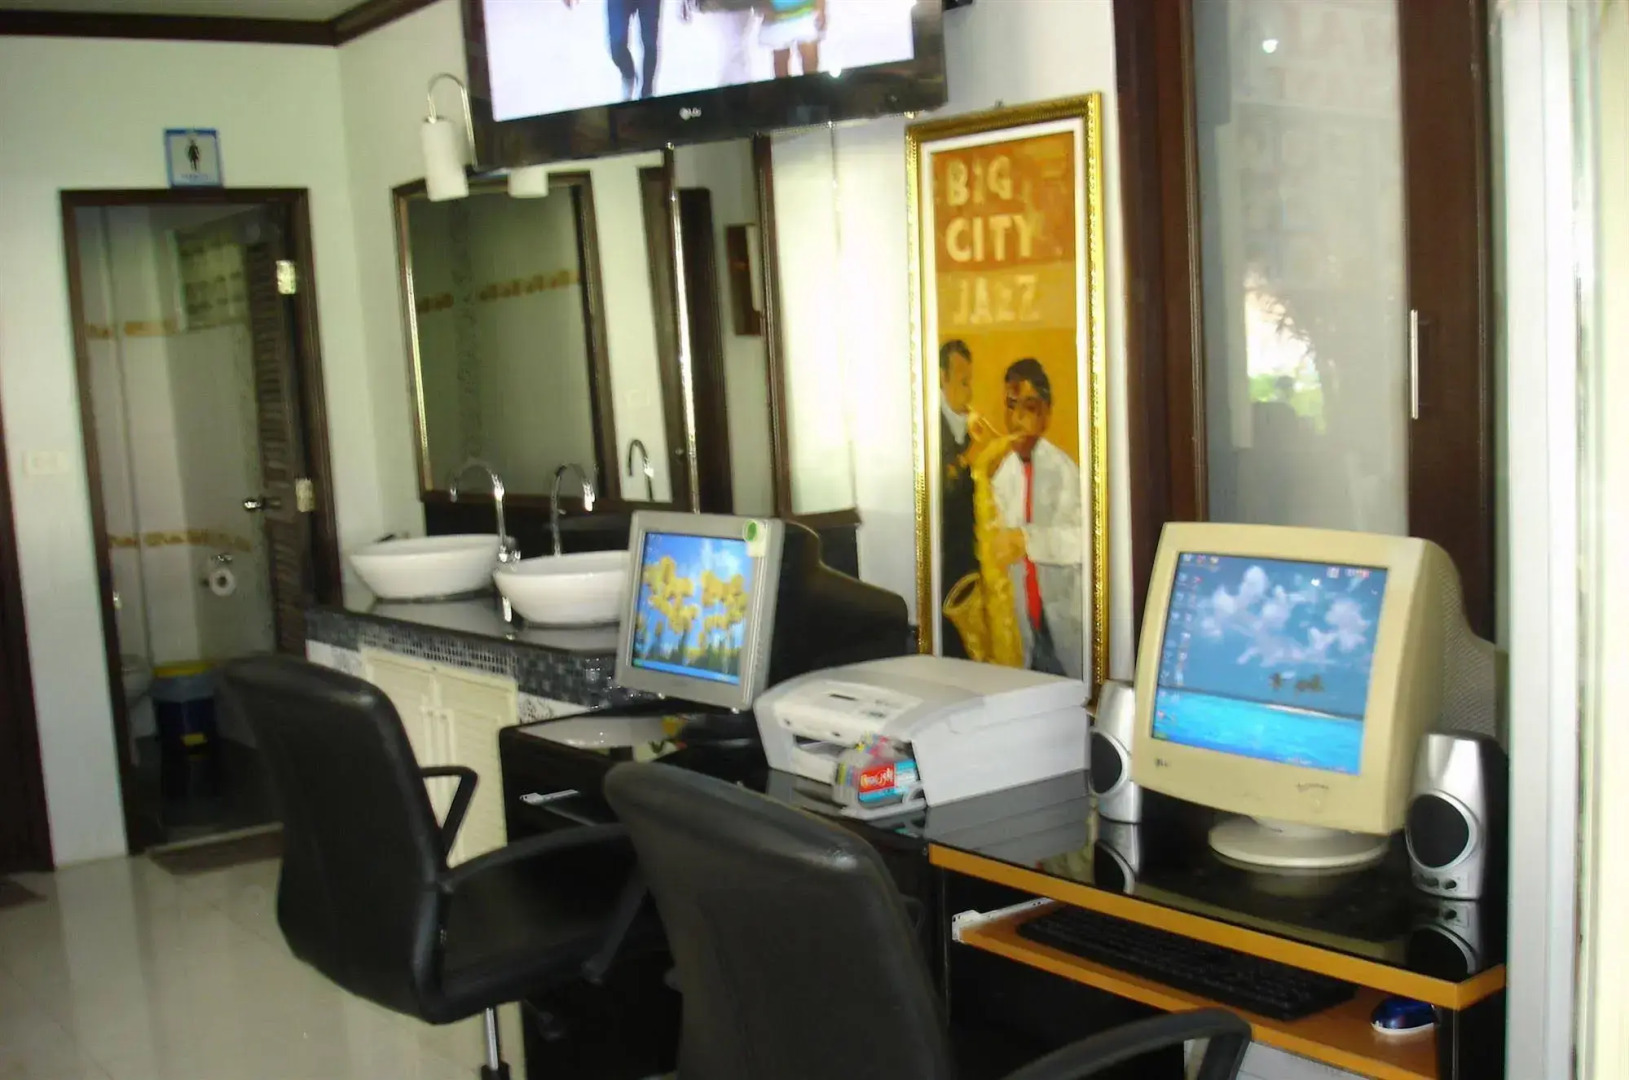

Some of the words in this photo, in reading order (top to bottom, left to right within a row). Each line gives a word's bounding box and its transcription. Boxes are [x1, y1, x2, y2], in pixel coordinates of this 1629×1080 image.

[946, 155, 1013, 207] BIG
[945, 213, 1043, 262] CITY
[952, 274, 1041, 325] JAZZ
